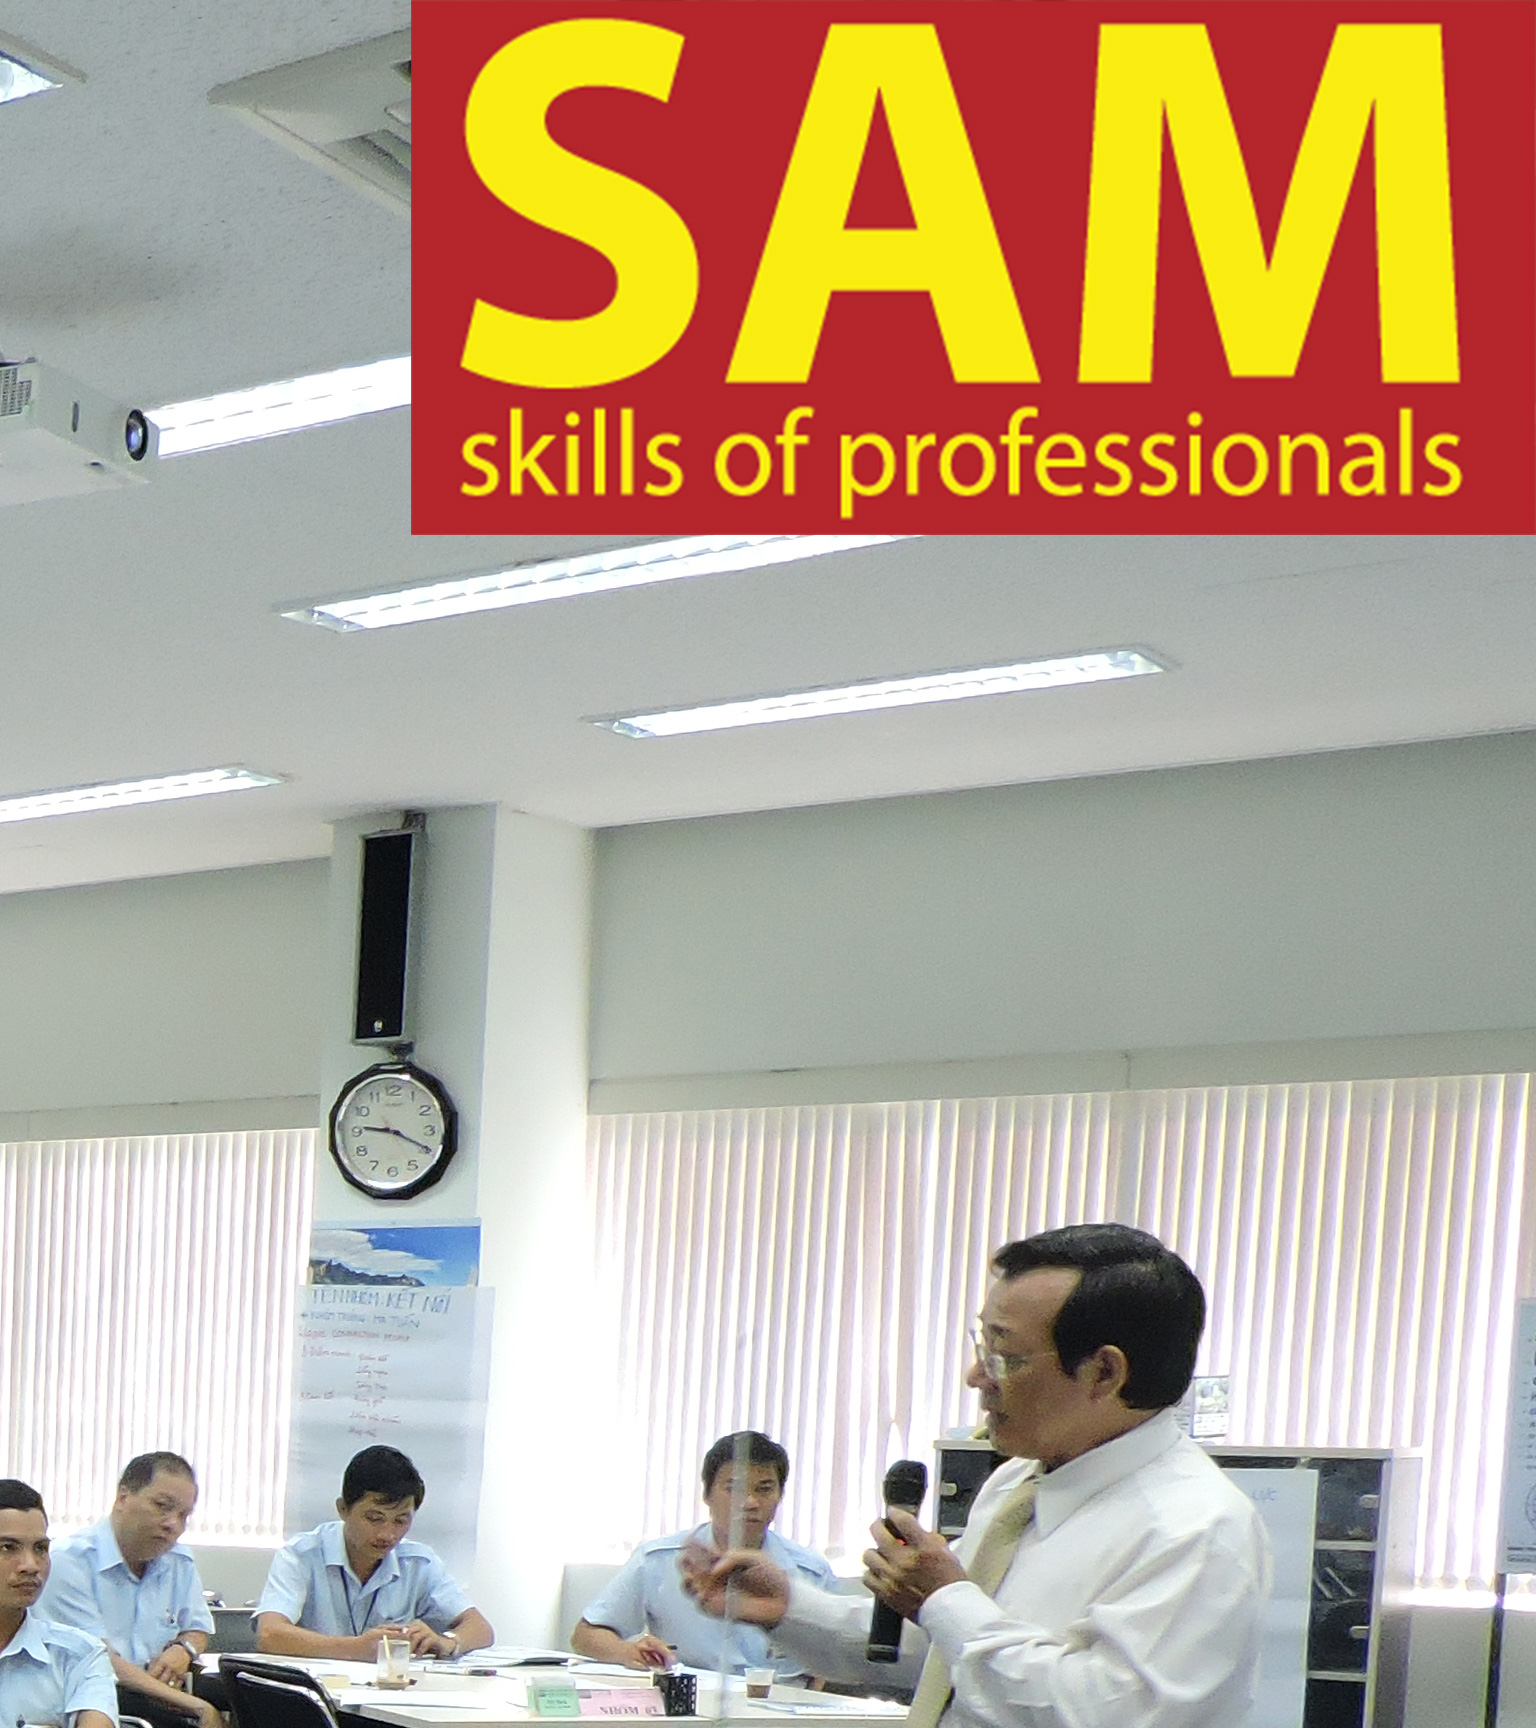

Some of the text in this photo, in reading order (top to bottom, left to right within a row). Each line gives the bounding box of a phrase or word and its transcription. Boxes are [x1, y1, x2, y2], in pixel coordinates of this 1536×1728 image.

[386, 1085, 402, 1096] 12
[369, 1092, 380, 1103] 11
[355, 1106, 370, 1117] 10
[419, 1105, 432, 1116] 2
[352, 1126, 362, 1137] 9
[424, 1125, 436, 1136] 3
[356, 1145, 368, 1157] 8
[369, 1160, 379, 1171] 7
[407, 1160, 419, 1171] 5
[387, 1166, 398, 1177] 6
